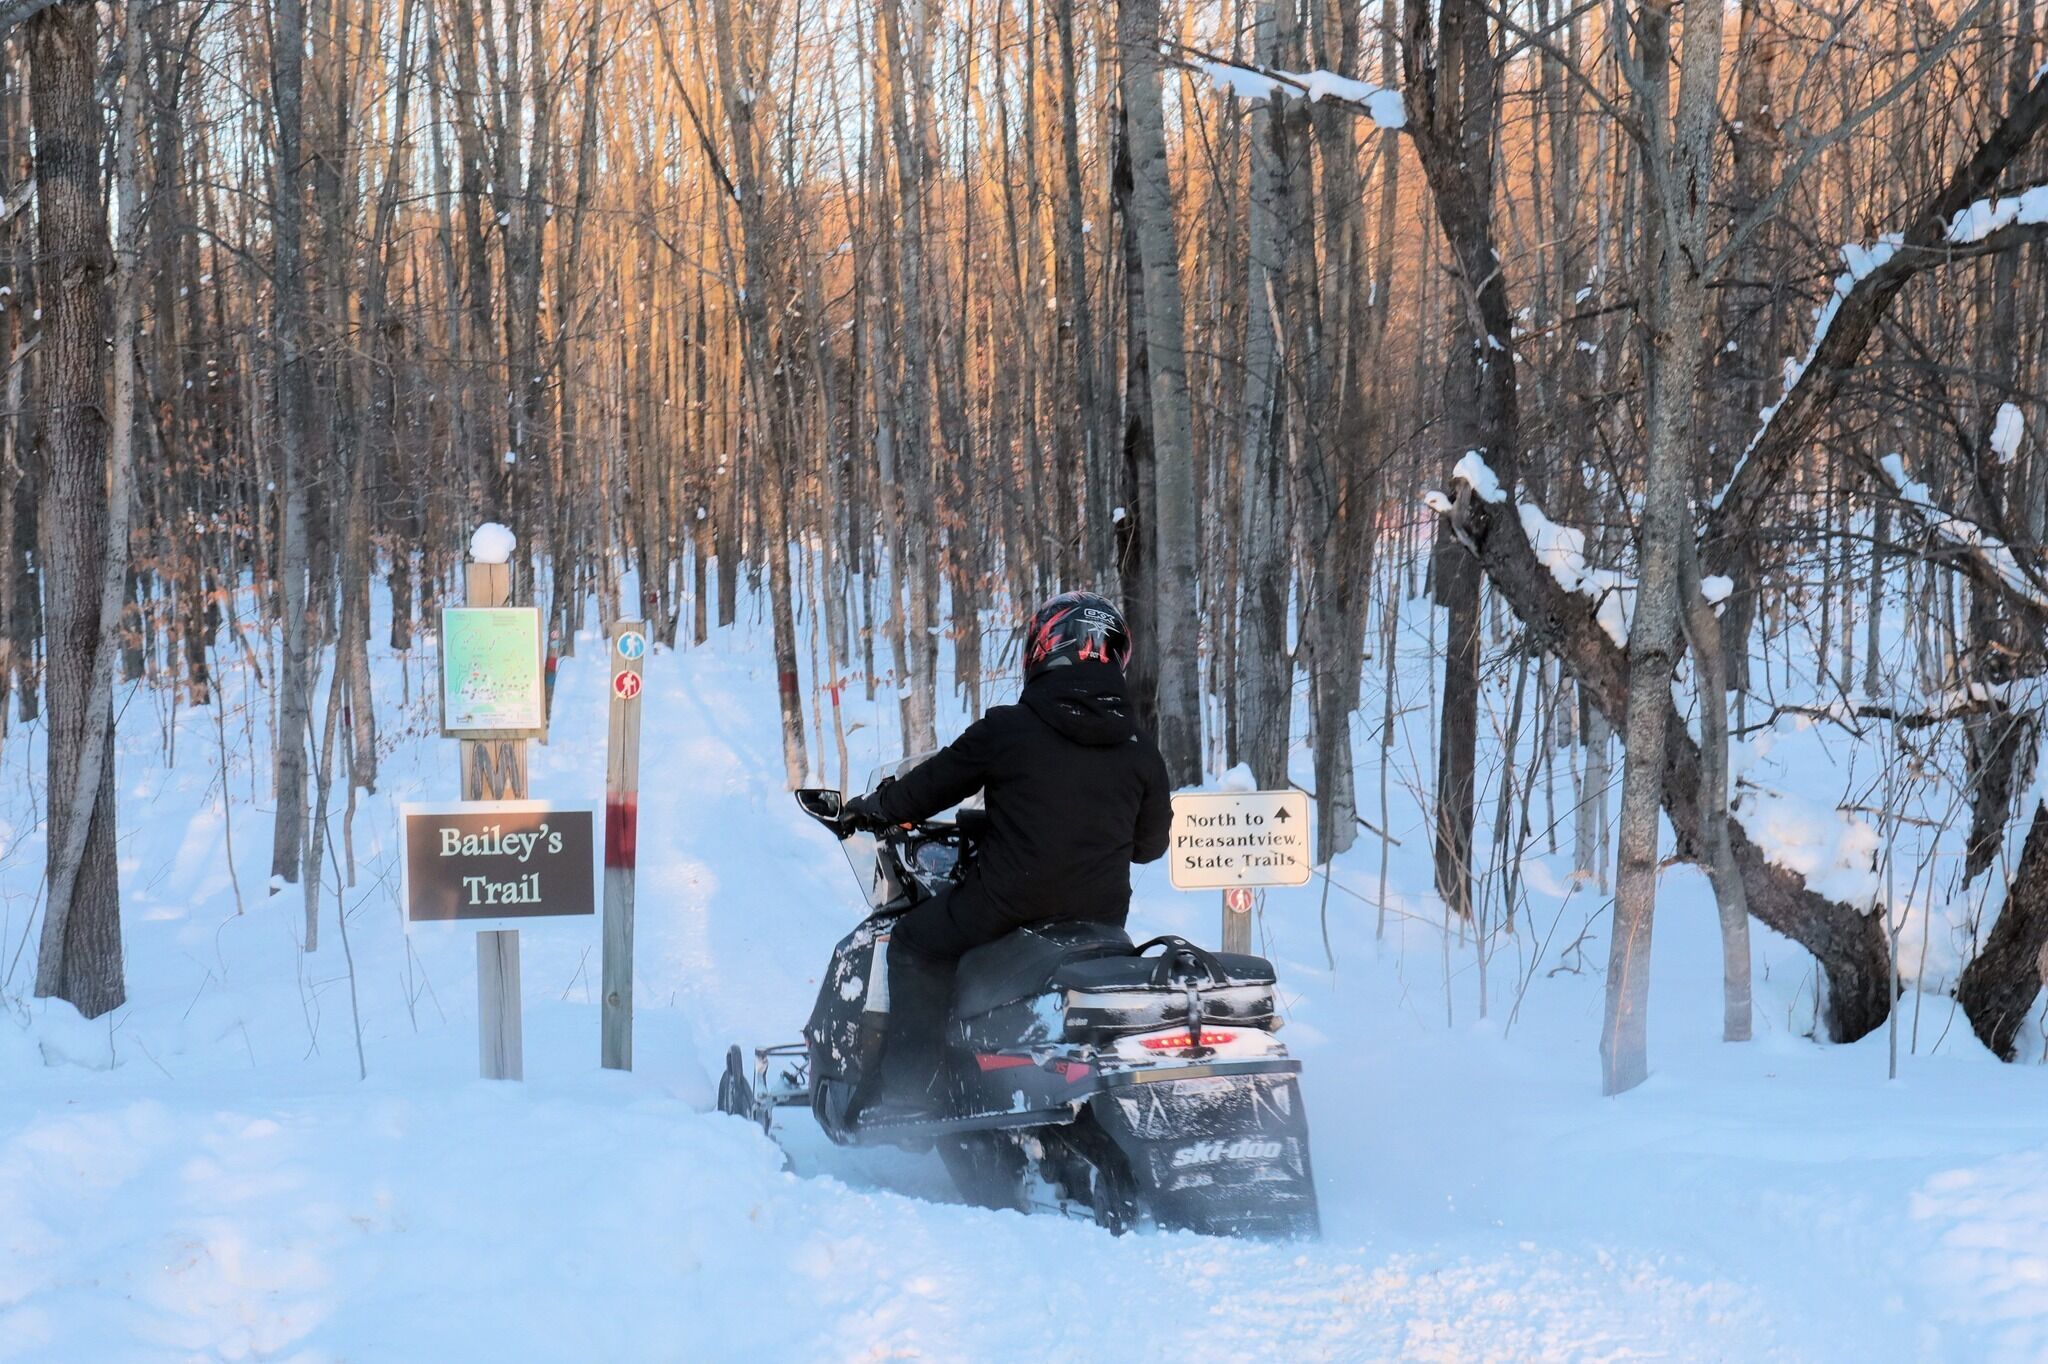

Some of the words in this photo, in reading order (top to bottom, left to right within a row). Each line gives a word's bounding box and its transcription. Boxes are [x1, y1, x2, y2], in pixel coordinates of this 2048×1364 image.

[1186, 813, 1236, 828] North
[1246, 812, 1264, 826] to
[439, 823, 563, 862] Bailey's
[1185, 855, 1234, 869] State
[1242, 853, 1296, 867] Trails
[463, 872, 542, 904] Trail
[1172, 1140, 1283, 1167] ski-doo
